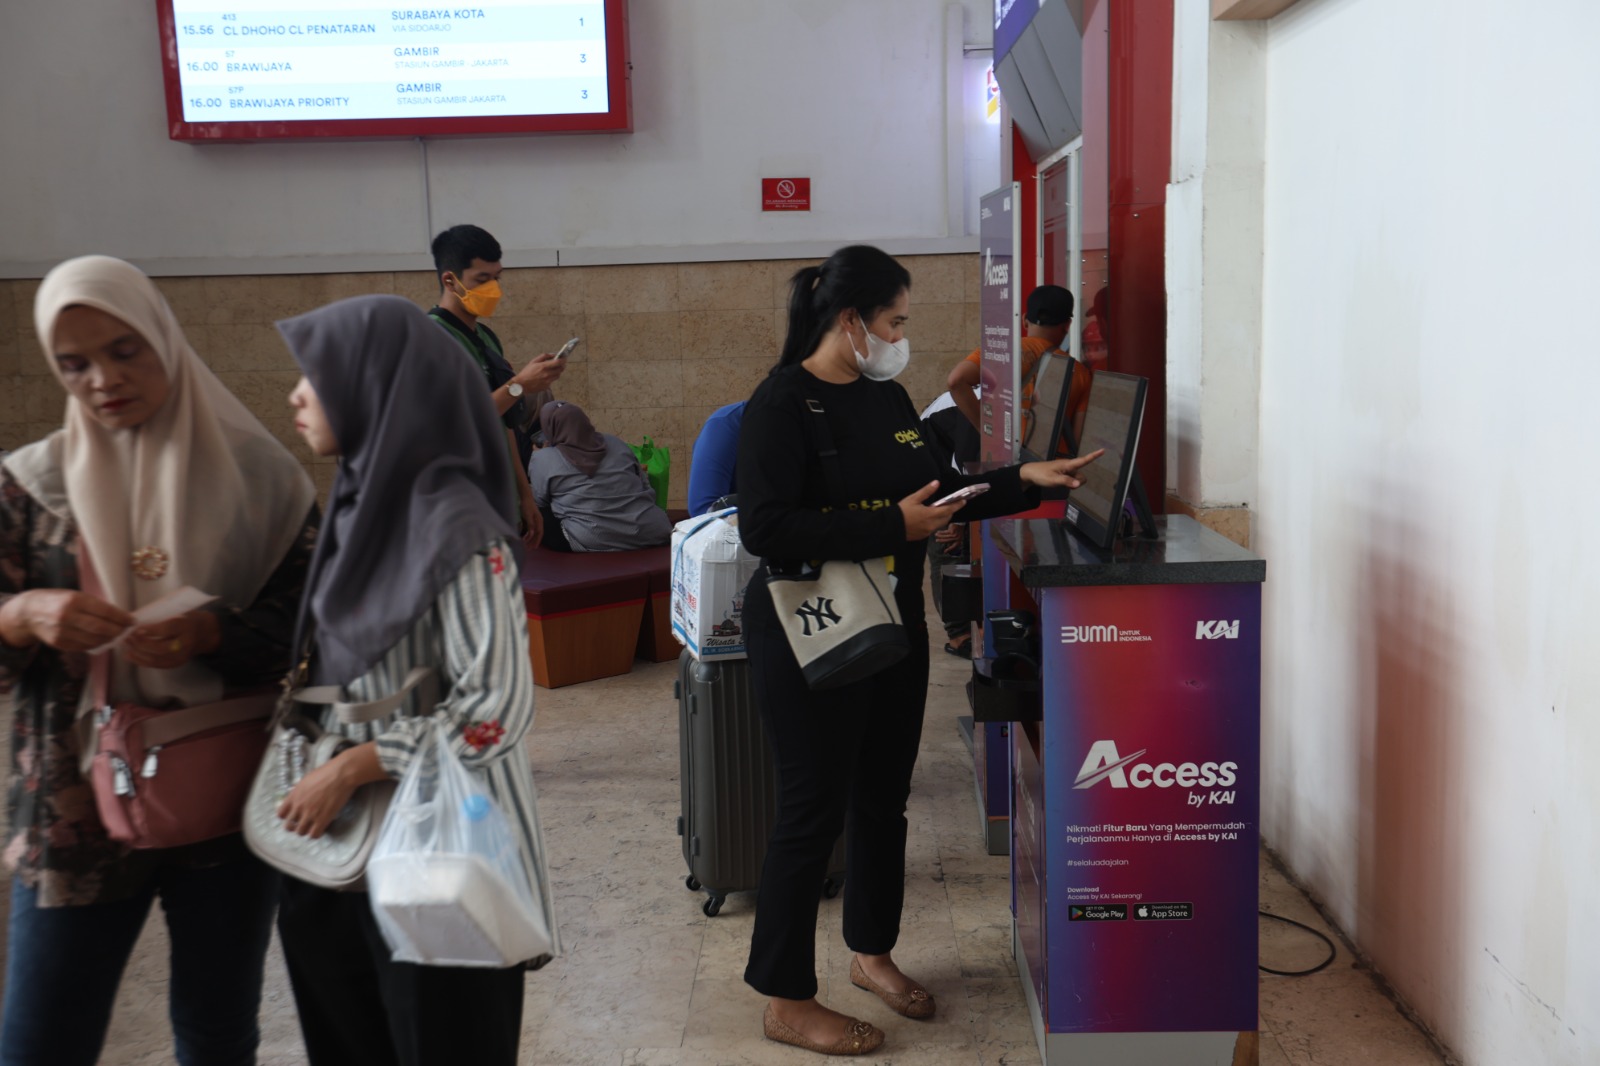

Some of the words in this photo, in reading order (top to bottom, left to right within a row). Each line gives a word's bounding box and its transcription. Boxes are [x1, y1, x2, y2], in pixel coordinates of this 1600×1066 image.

[392, 10, 451, 20] SURABAYA
[454, 9, 485, 19] KOTA
[579, 17, 584, 27] 1
[183, 25, 214, 35] 15.56
[223, 26, 239, 36] CL
[242, 25, 286, 35] DHOHO
[289, 25, 304, 35] CL
[307, 24, 376, 34] PENATARAN
[408, 23, 452, 32] SIDOARJO
[394, 47, 440, 57] GAMBIR
[580, 53, 587, 63] 3
[187, 61, 219, 71] 16.00
[227, 62, 292, 72] BRAWIJAYA
[395, 60, 430, 69] STASIUN
[432, 59, 465, 68] GAMBIR
[471, 58, 509, 67] JAKARTA
[228, 86, 244, 94] 57P
[396, 83, 442, 93] GAMBIR
[581, 89, 588, 99] 3
[190, 98, 222, 108] 16.00
[230, 98, 295, 109] BRAWIJAYA
[298, 97, 350, 107] PRIORITY
[397, 96, 432, 105] STASIUN
[434, 96, 467, 104] GAMBIR
[469, 95, 507, 103] JAKARTA
[984, 247, 1009, 286] Access
[1195, 619, 1240, 640] KAI
[1071, 740, 1239, 789] Access
[1187, 791, 1206, 808] by
[1208, 791, 1236, 805] KAI
[1066, 824, 1101, 833] Nikmati
[1103, 823, 1125, 832] Fitur
[1125, 824, 1148, 832] Baru
[1149, 823, 1173, 833] Yang
[1175, 821, 1245, 832] Mempermudah
[1066, 835, 1130, 845] Perjalananmu
[1131, 834, 1161, 844] Hanya
[1163, 833, 1172, 841] di
[1174, 833, 1207, 841] Access
[1208, 832, 1220, 843] by
[1221, 832, 1238, 840] KAI
[1067, 858, 1129, 868] #selaluadajalan
[1091, 893, 1099, 901] by
[1111, 892, 1143, 900] Sekarang!
[1085, 910, 1110, 919] Google
[1110, 910, 1125, 919] Play
[1151, 910, 1167, 918] App
[1168, 909, 1188, 917] Store
